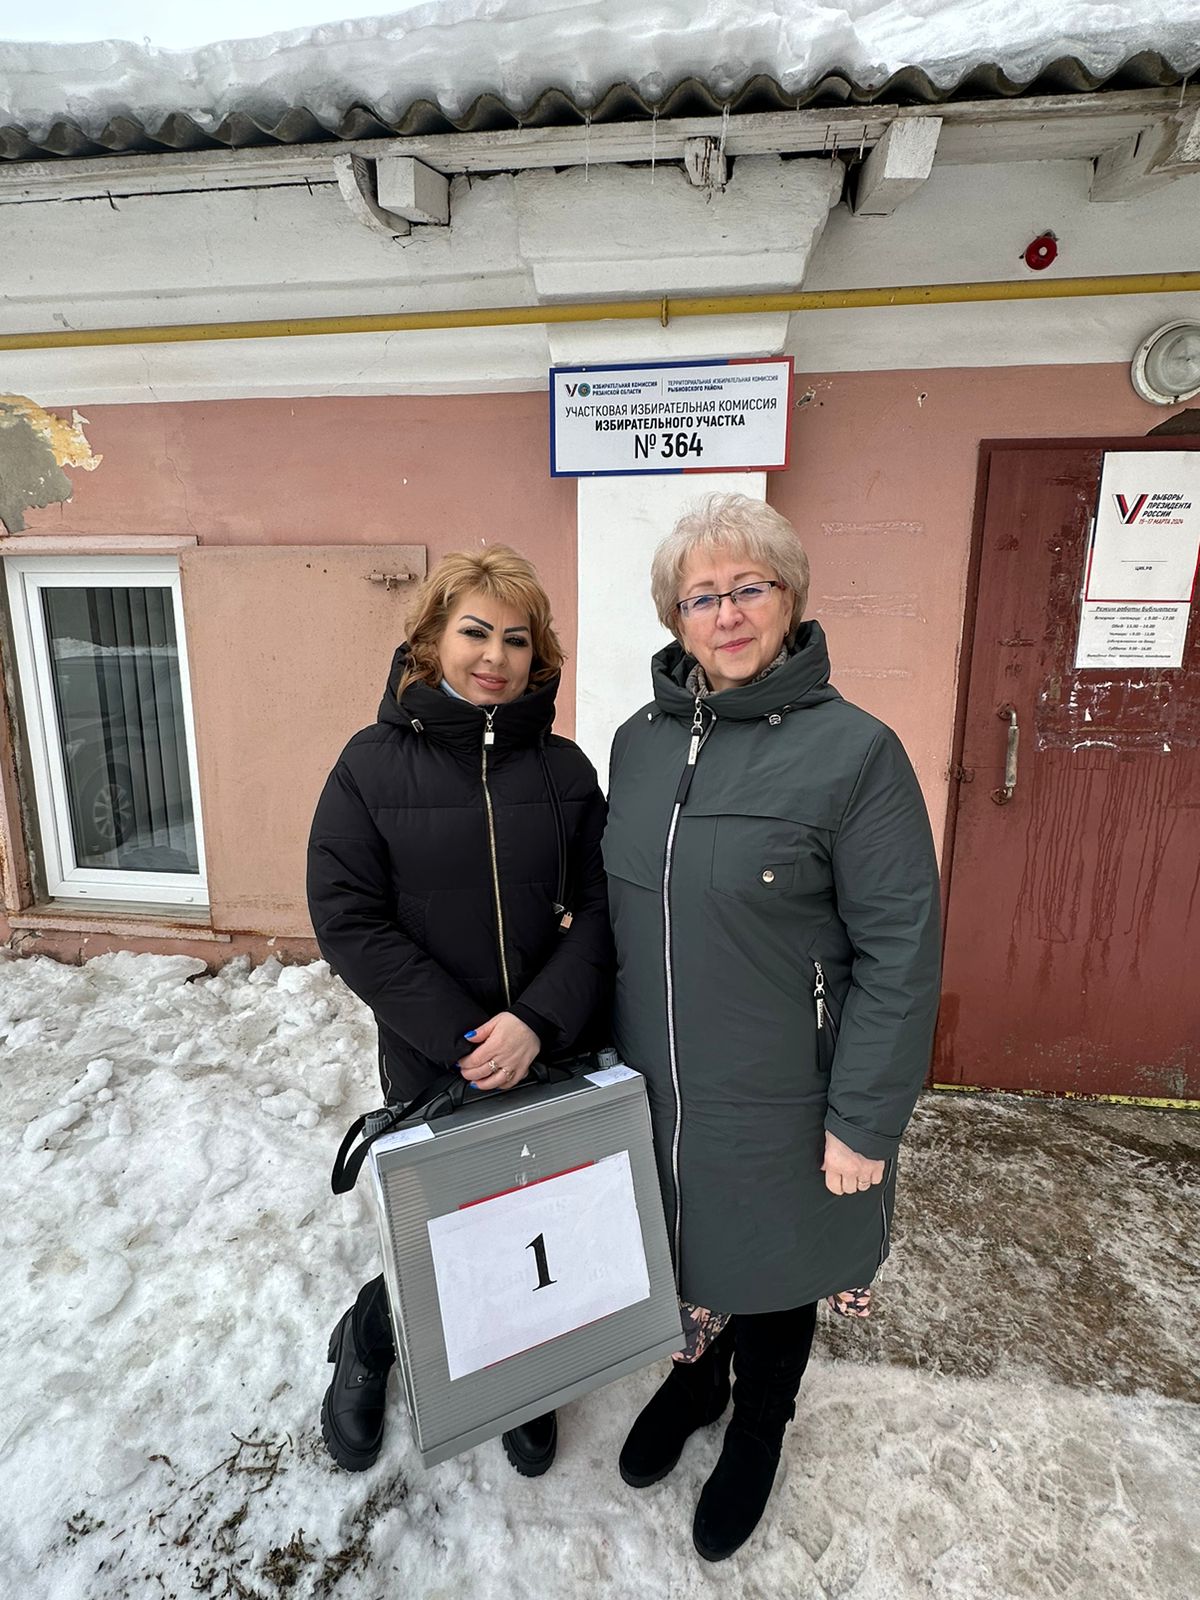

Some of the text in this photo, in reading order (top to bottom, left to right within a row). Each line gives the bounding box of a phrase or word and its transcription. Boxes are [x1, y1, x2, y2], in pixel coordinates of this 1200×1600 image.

[712, 376, 751, 384] ИЗБИРАТЕЛЬНАЯ
[592, 382, 630, 390] ИЗБИРАТЕЛЬНАЯ
[565, 397, 778, 418] УЧАСТКОВАЯ ИЗБИРАТЕЛЬНАЯ КОМИССИЯ
[595, 414, 746, 431] ИЗБИРАТЕЛЬНОГО УЧАСТКА
[660, 432, 704, 458] 364
[1151, 493, 1184, 501] ВЫБОРЫ
[1146, 502, 1192, 510] ПРЕЗИДЕНТА
[1142, 510, 1172, 518] РОССИИ
[525, 1233, 558, 1291] 1
